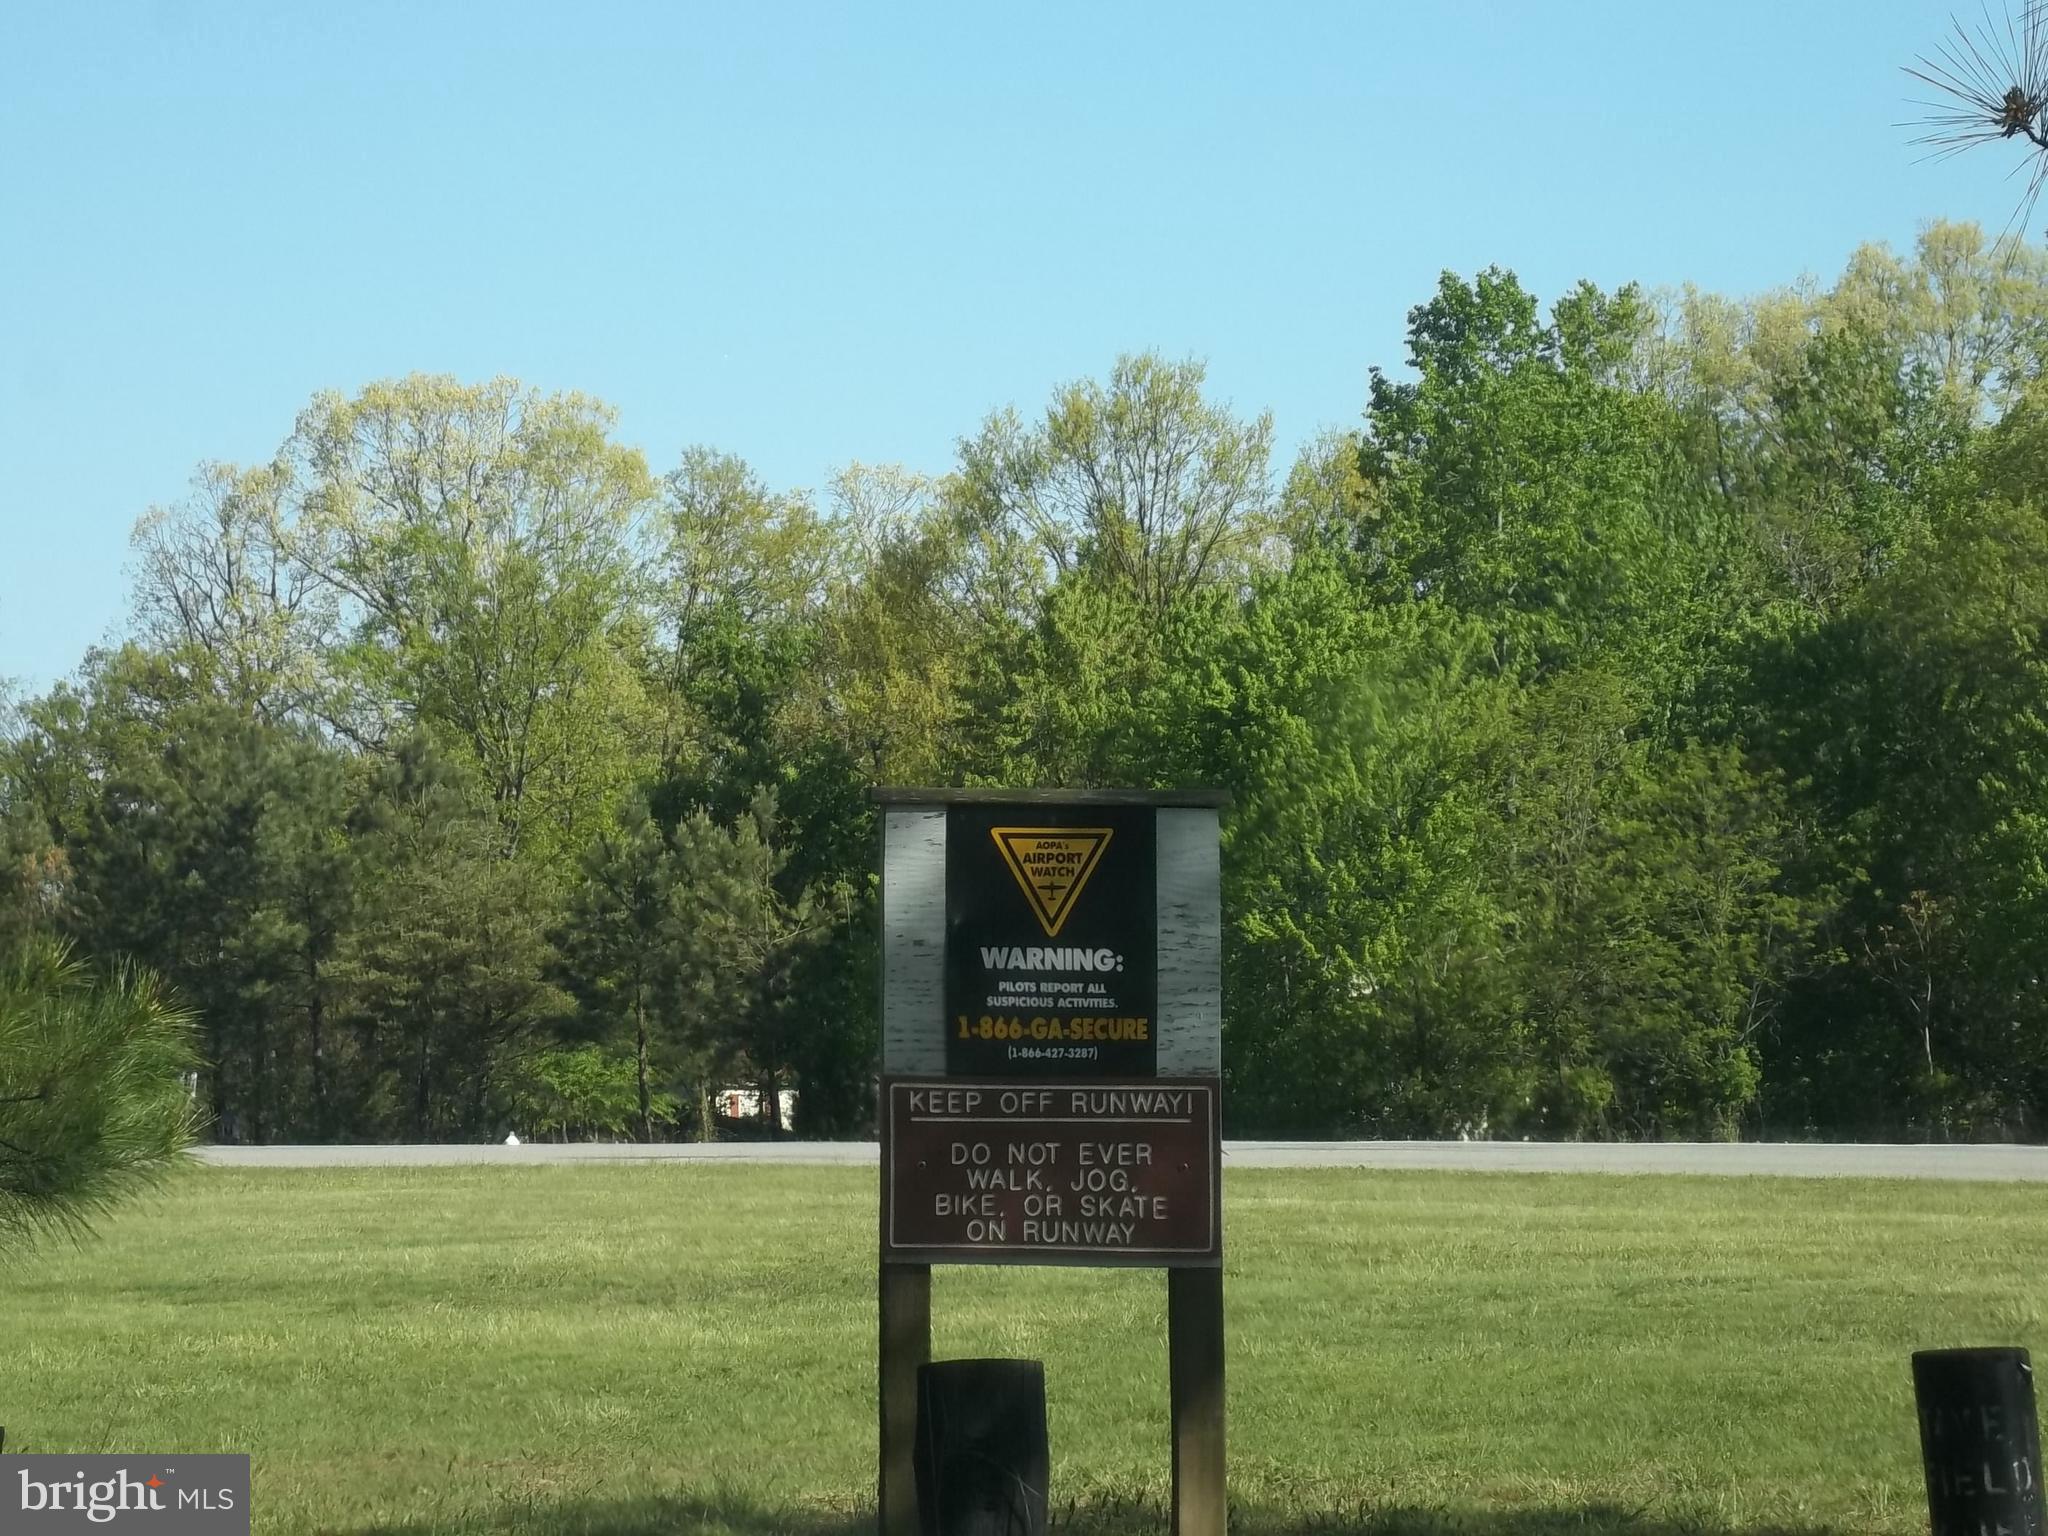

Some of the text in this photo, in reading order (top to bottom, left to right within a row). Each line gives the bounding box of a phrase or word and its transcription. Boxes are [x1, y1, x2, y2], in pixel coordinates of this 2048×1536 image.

[1035, 840, 1069, 850] AOPA's
[1022, 852, 1083, 865] AIRPORT
[1030, 865, 1075, 878] WATCH
[980, 947, 1124, 972] WARNING:
[998, 981, 1107, 994] PILOTS REPORT ALL
[986, 996, 1119, 1009] SUSPICIOUS ACTIVITIES.
[957, 1016, 1149, 1040] 1-866-GA-SECURE
[1007, 1046, 1098, 1061] (1-866-427-3287)
[909, 1090, 982, 1114] KEEP
[1000, 1091, 1055, 1114] OFF
[951, 1142, 1152, 1165] DO NOT EVER
[1024, 1195, 1063, 1217] OR
[1080, 1195, 1168, 1220] SKATE
[966, 1219, 1136, 1245] ON RUNWAY
